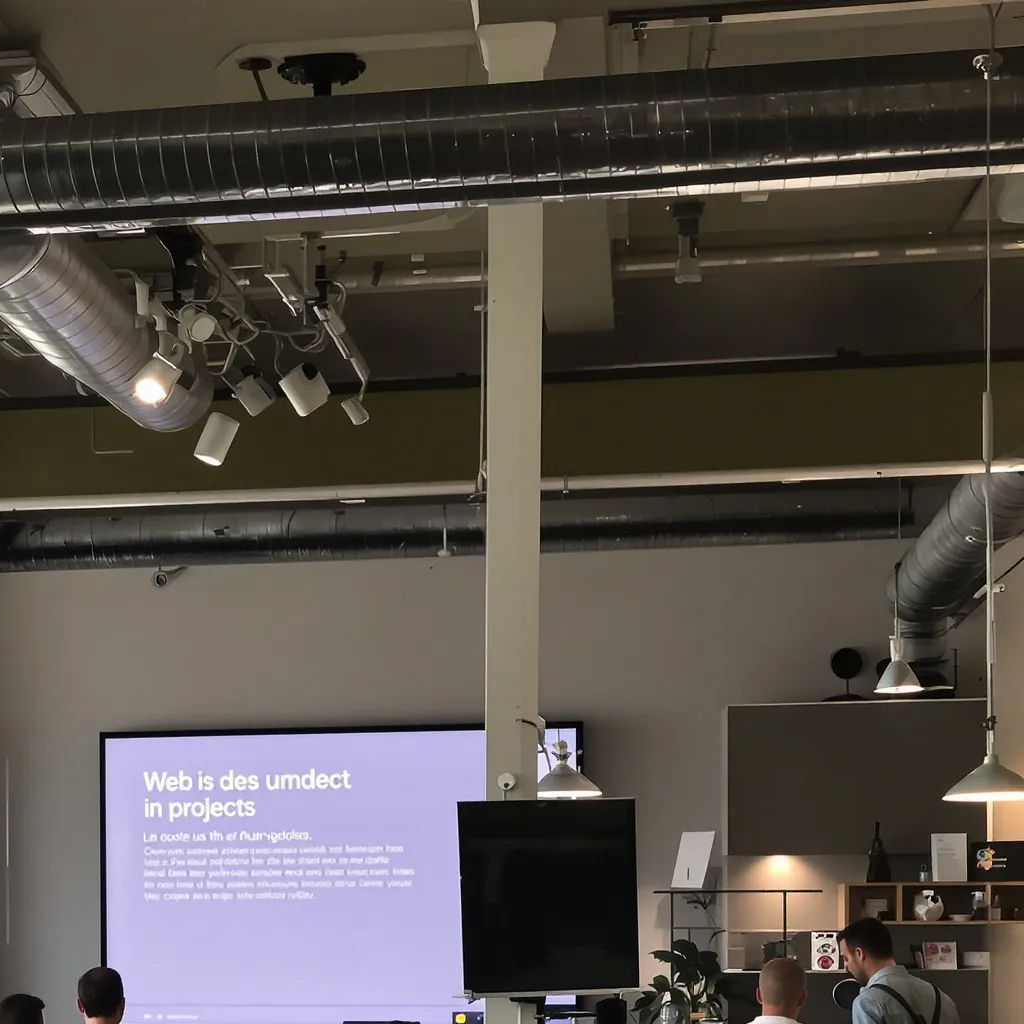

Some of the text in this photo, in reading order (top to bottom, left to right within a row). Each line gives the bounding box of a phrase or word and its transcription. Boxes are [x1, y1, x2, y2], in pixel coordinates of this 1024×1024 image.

[142, 769, 193, 792] Web
[197, 770, 215, 791] is
[219, 769, 260, 791] des
[144, 797, 257, 824] in projects
